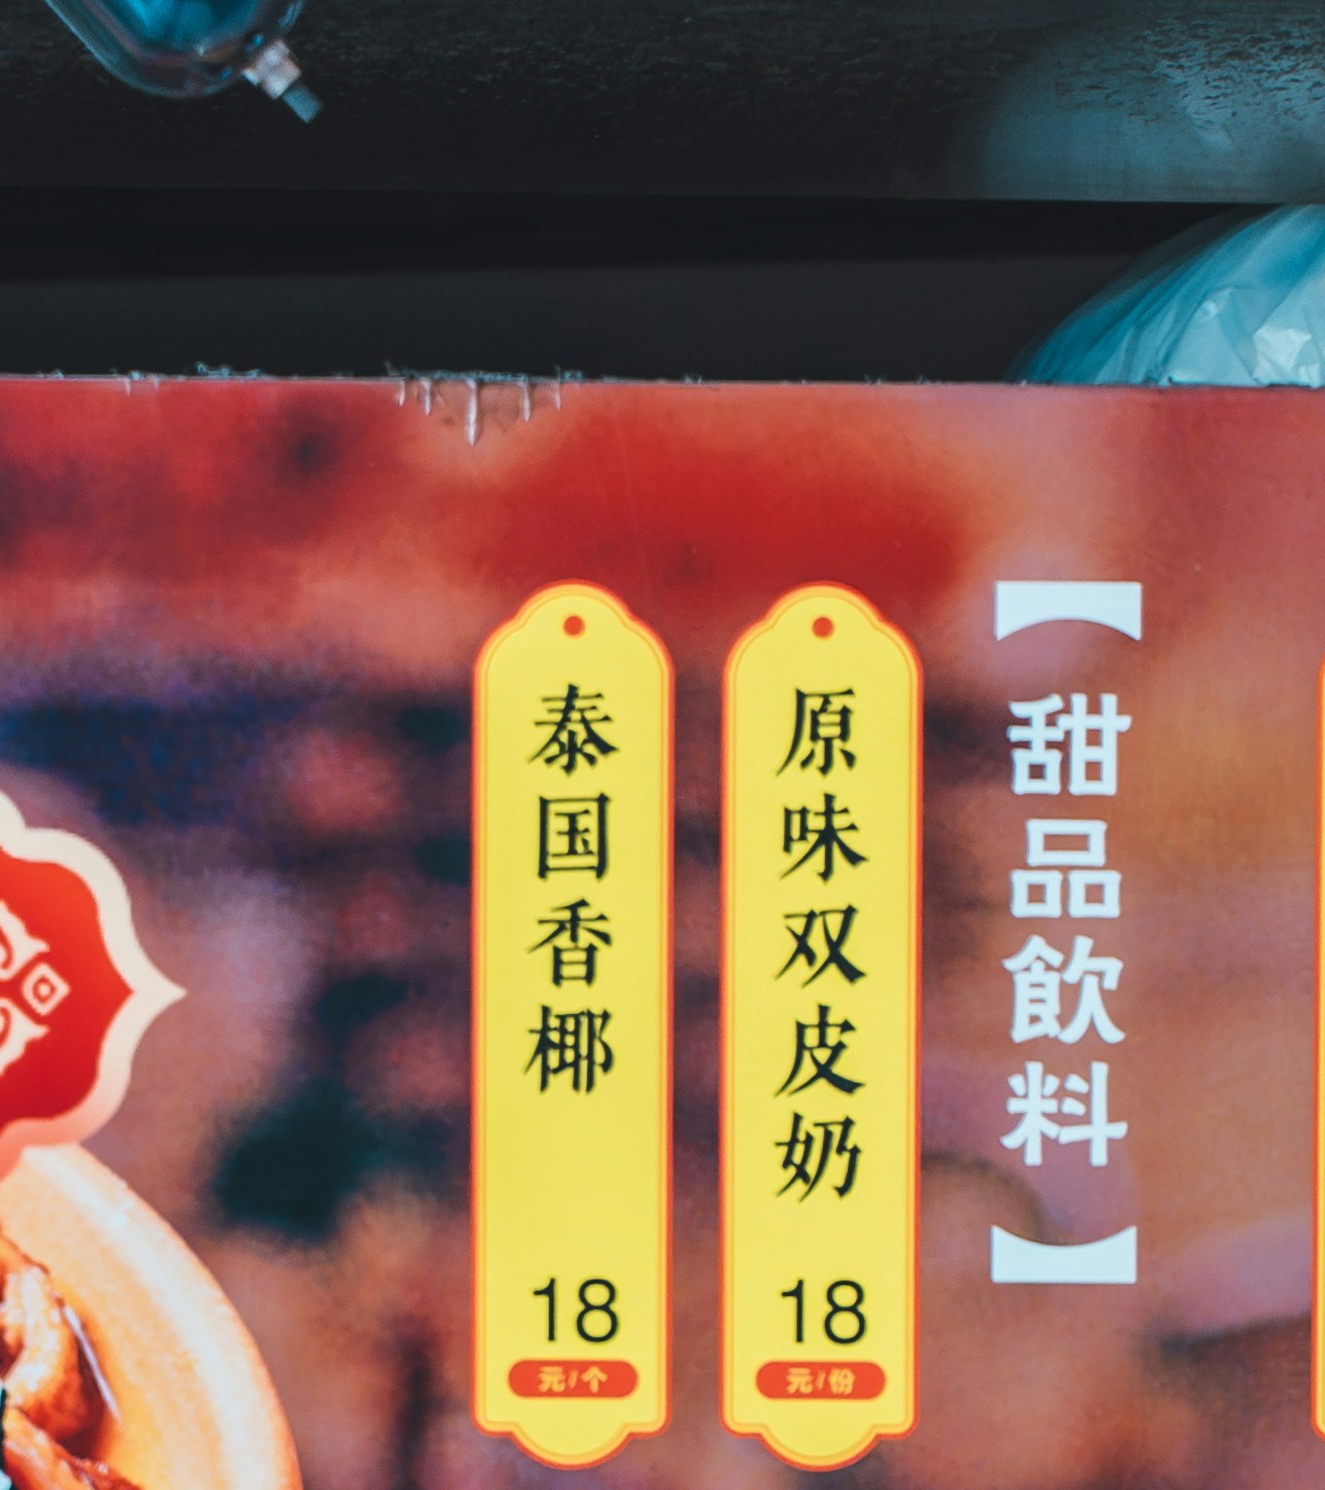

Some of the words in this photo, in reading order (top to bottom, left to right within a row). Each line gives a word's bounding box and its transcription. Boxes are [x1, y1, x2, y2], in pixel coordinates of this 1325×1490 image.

[526, 683, 618, 1093] 泰国香椰
[775, 688, 867, 1199] 原味双皮奶
[532, 1277, 619, 1344] 18
[781, 1279, 867, 1345] 18
[538, 1366, 608, 1394] 元/个
[786, 1368, 855, 1395] 元/份
